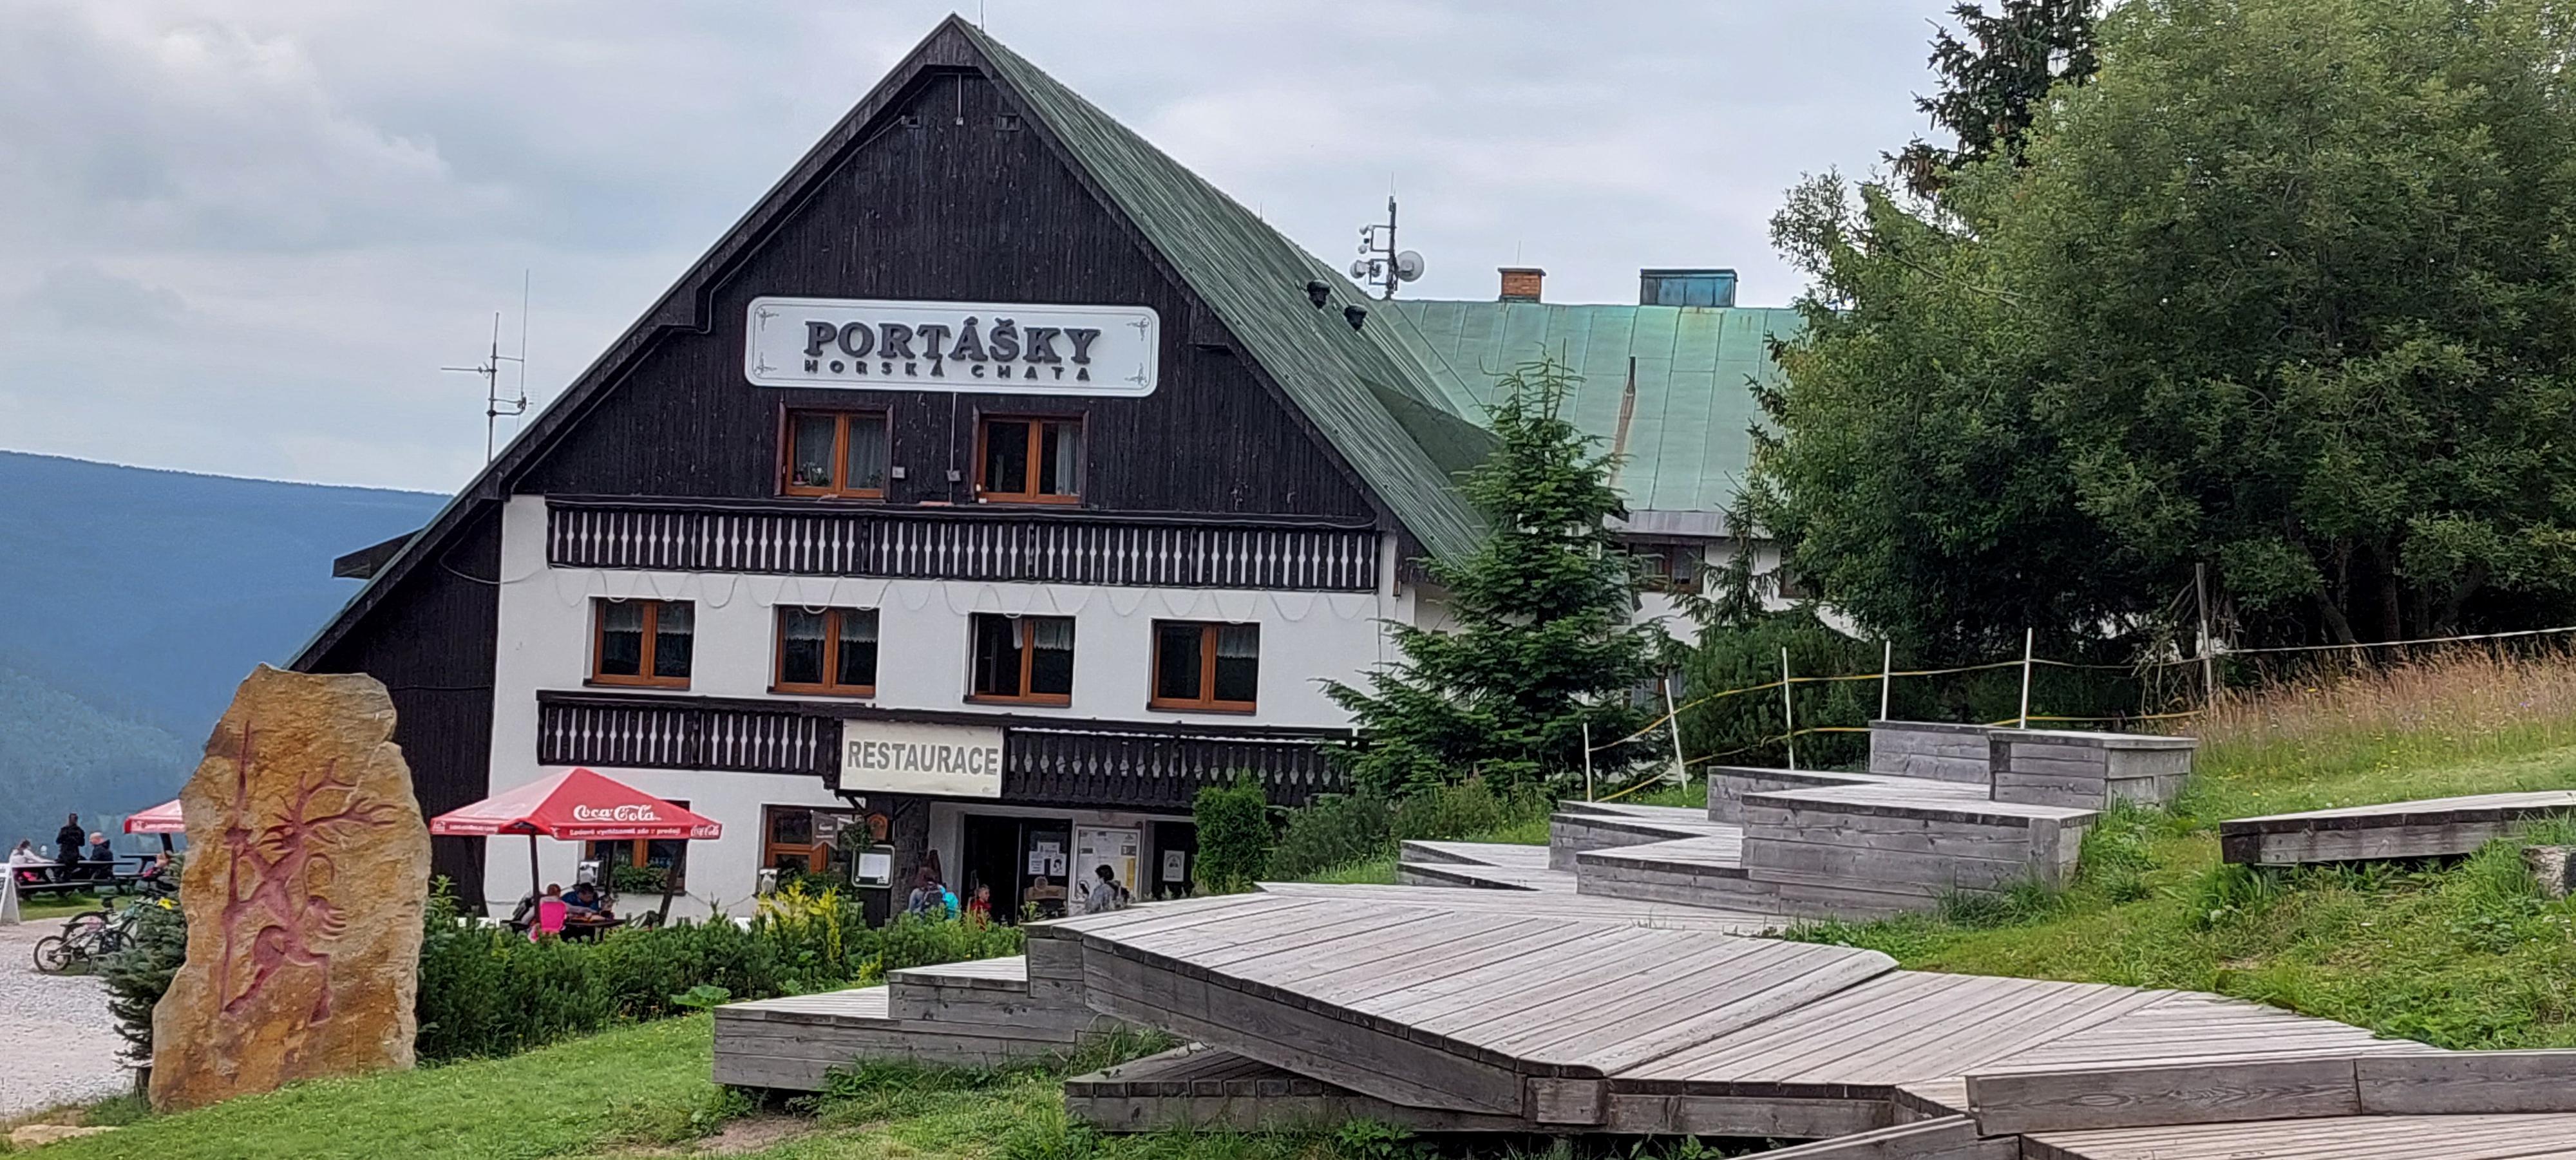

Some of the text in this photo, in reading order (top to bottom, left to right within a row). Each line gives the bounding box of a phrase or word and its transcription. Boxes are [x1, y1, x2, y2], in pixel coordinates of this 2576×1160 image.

[803, 316, 1102, 364] PORTÁŠKY
[804, 358, 1091, 381] HORSKÁ CHATA
[847, 740, 999, 776] RESTAURACE
